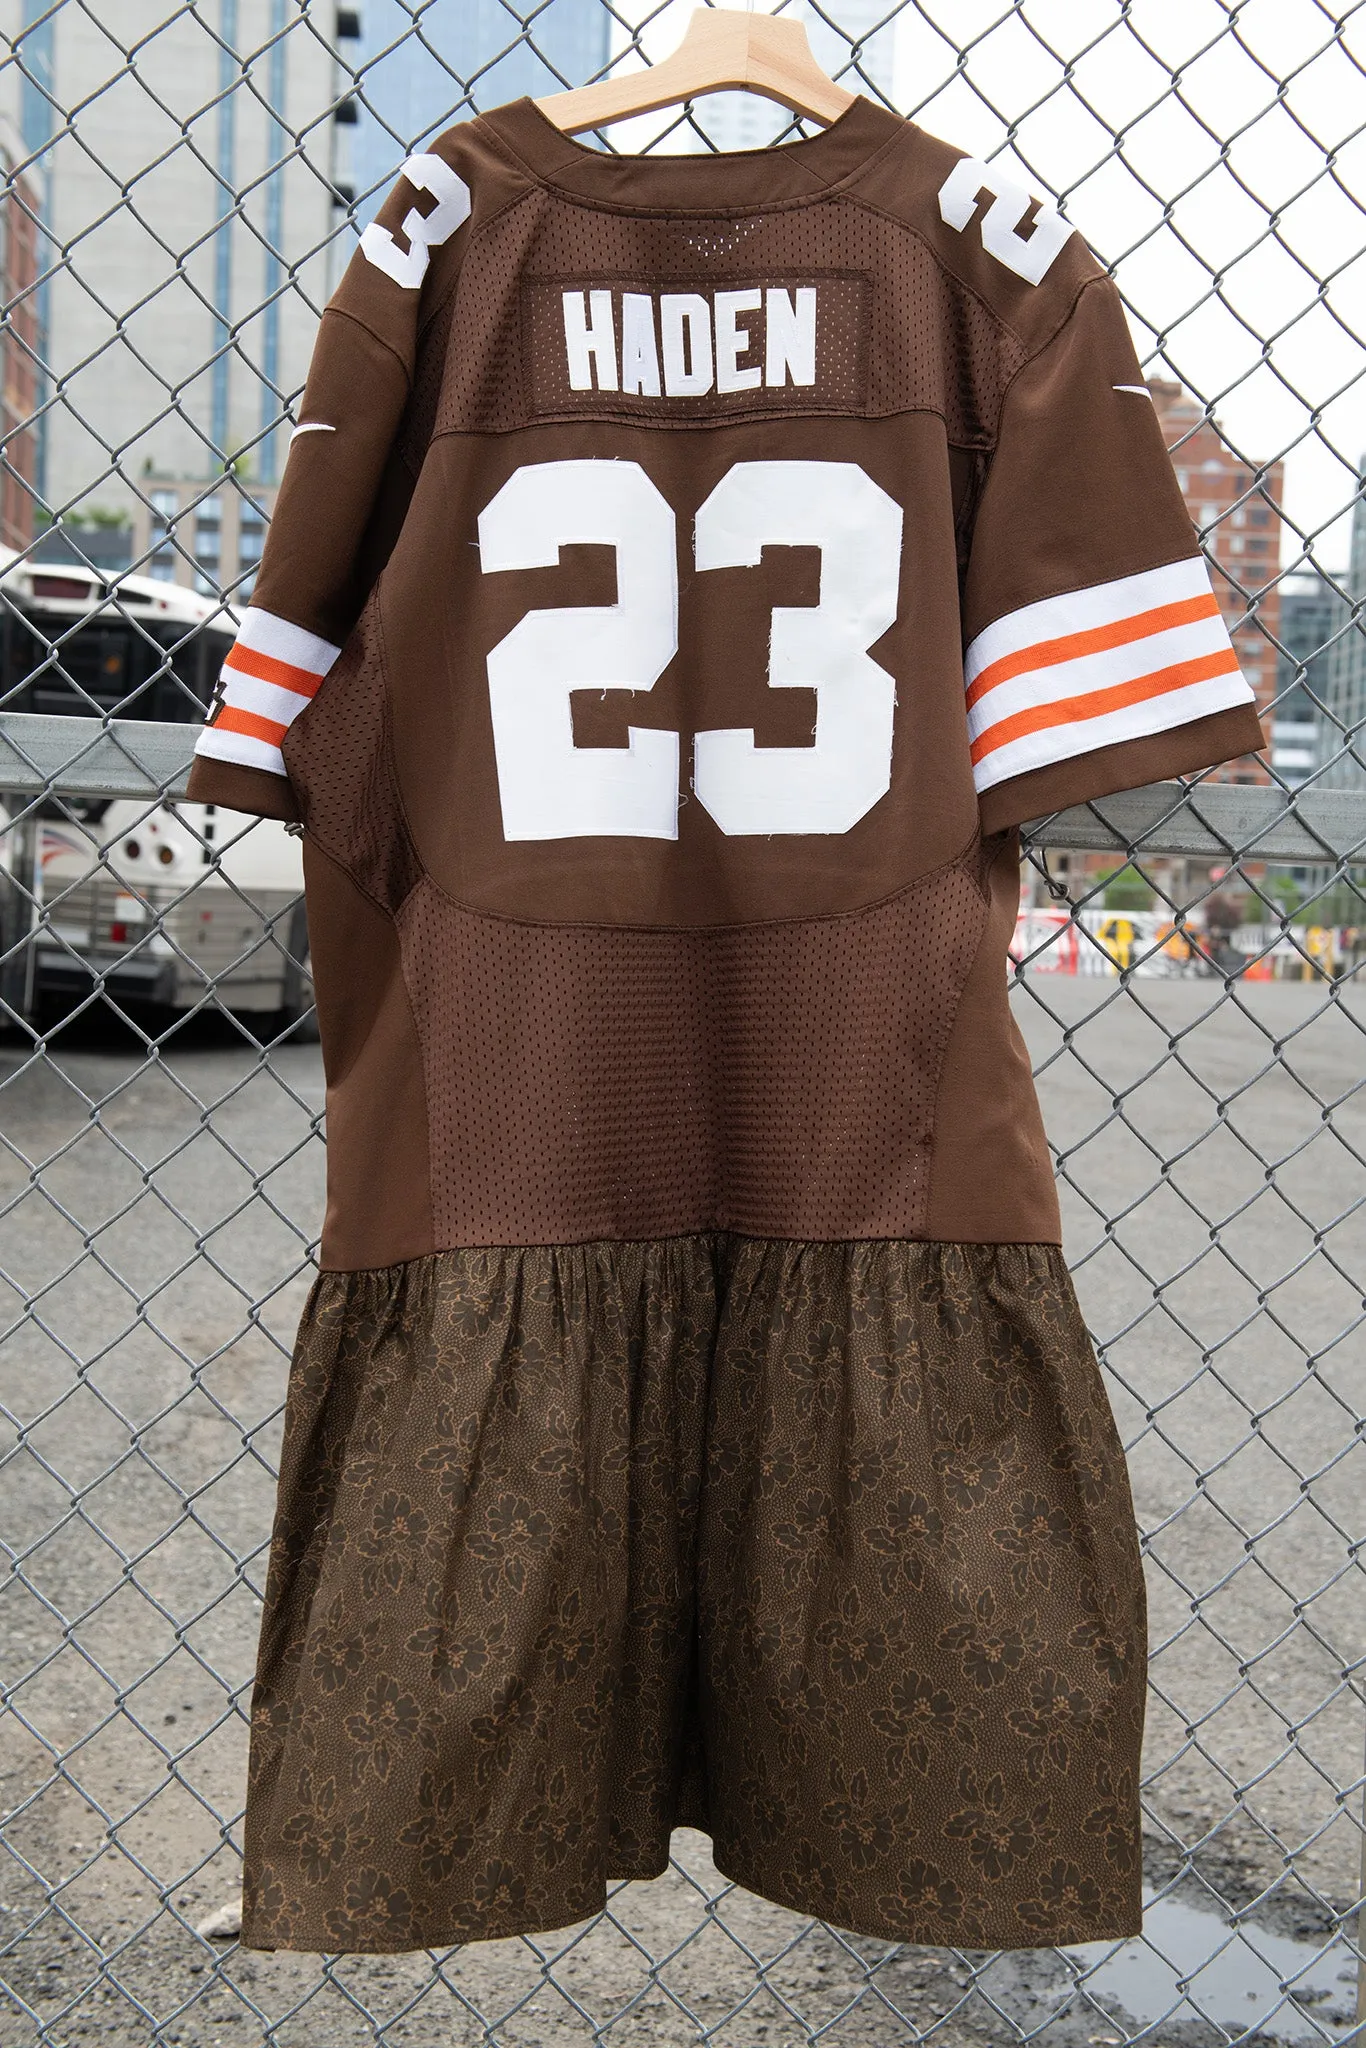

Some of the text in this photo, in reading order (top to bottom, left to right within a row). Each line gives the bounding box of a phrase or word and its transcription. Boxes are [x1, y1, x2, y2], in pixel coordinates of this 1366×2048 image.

[358, 153, 472, 289] 3
[562, 288, 817, 397] HADEN
[477, 459, 904, 841] 23
